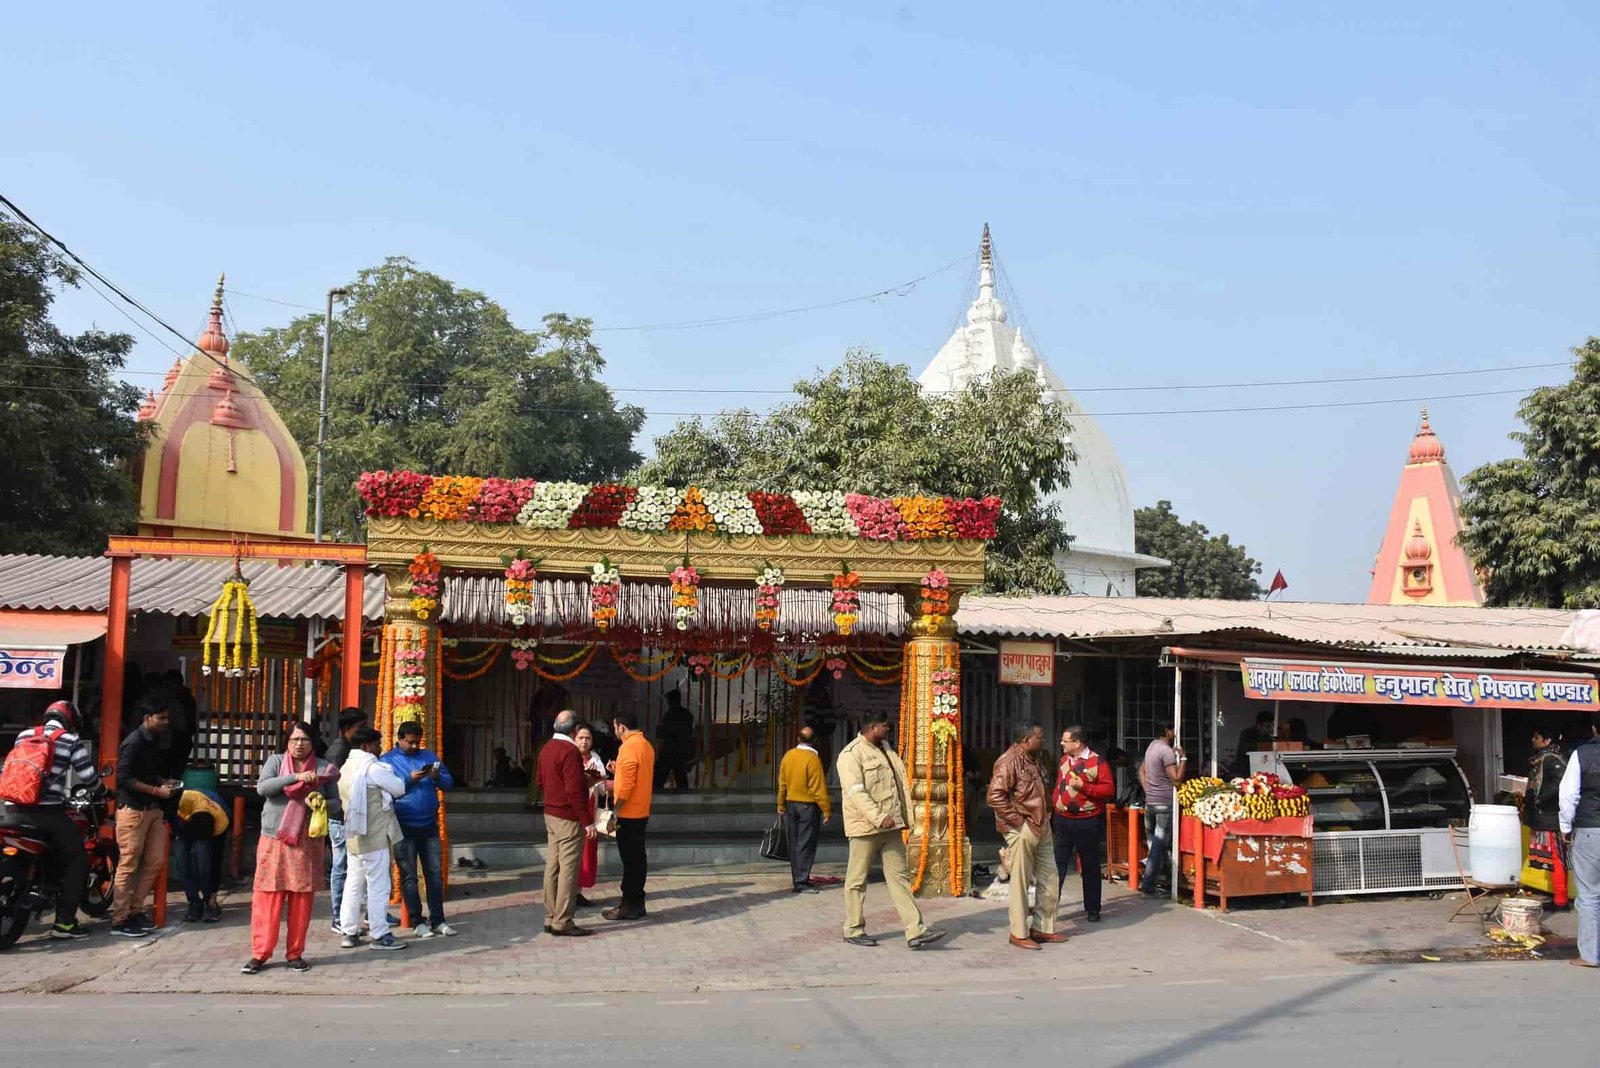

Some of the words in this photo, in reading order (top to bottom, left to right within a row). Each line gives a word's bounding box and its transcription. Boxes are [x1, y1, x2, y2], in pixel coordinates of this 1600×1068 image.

[1025, 654, 1051, 676] पादुका
[1248, 668, 1285, 696] अनुराग
[1321, 667, 1366, 694] डेकोरेशन
[1373, 674, 1437, 700] हनुमान
[1440, 672, 1474, 703] सेतु
[1477, 674, 1537, 701] मिष्ठान
[1541, 682, 1593, 703] भण्डार
